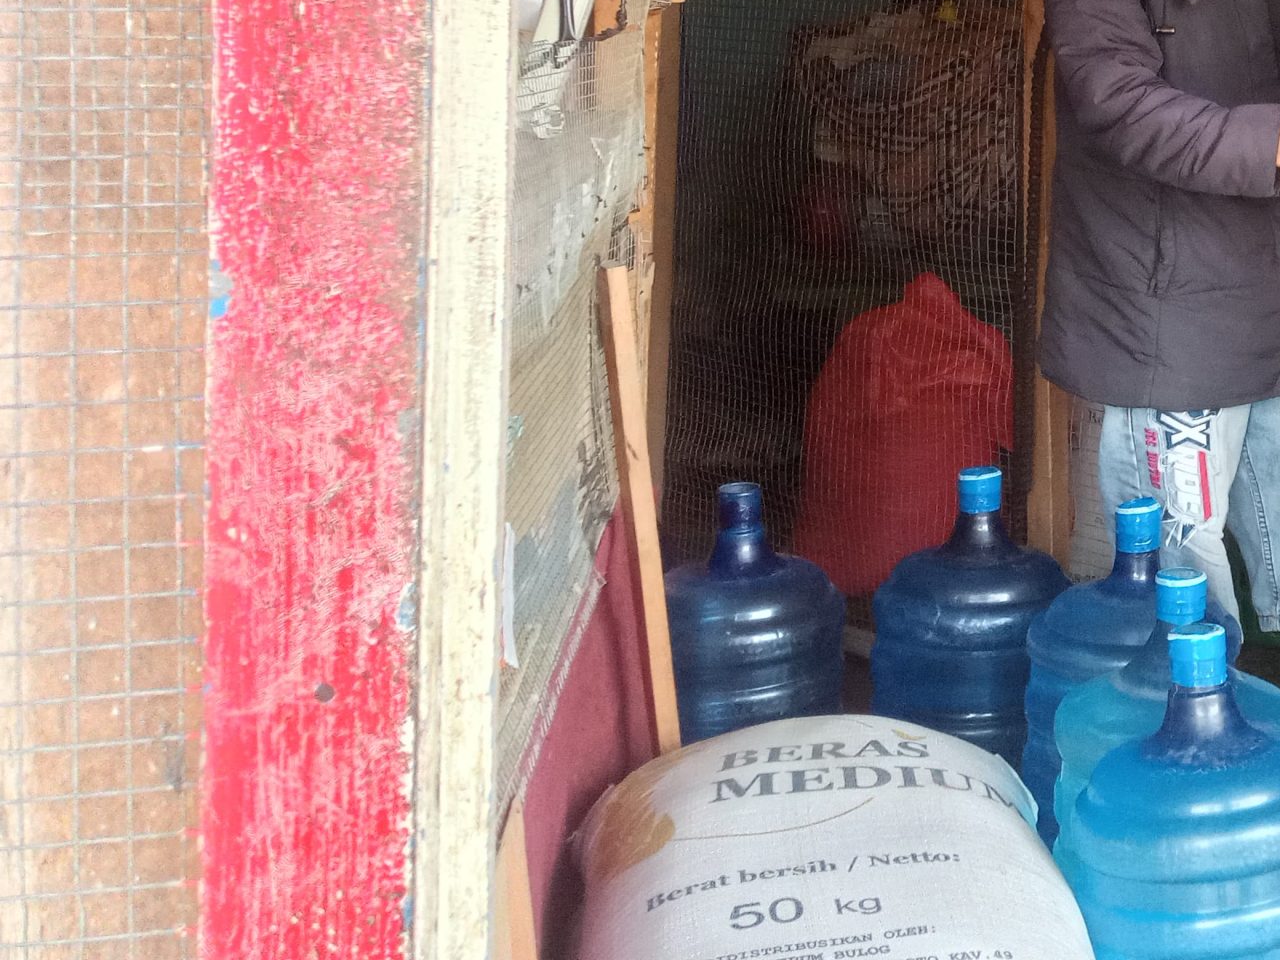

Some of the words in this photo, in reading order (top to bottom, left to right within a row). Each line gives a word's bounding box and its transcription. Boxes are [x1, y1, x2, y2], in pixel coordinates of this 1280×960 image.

[719, 739, 931, 774] BERAS
[645, 874, 733, 913] Berat
[737, 859, 838, 885] bersih
[846, 855, 859, 873] /
[868, 849, 962, 868] Netto:
[729, 897, 806, 931] 50
[835, 897, 884, 917] kg
[883, 925, 937, 940] OLEH:
[834, 944, 892, 959] BULOG
